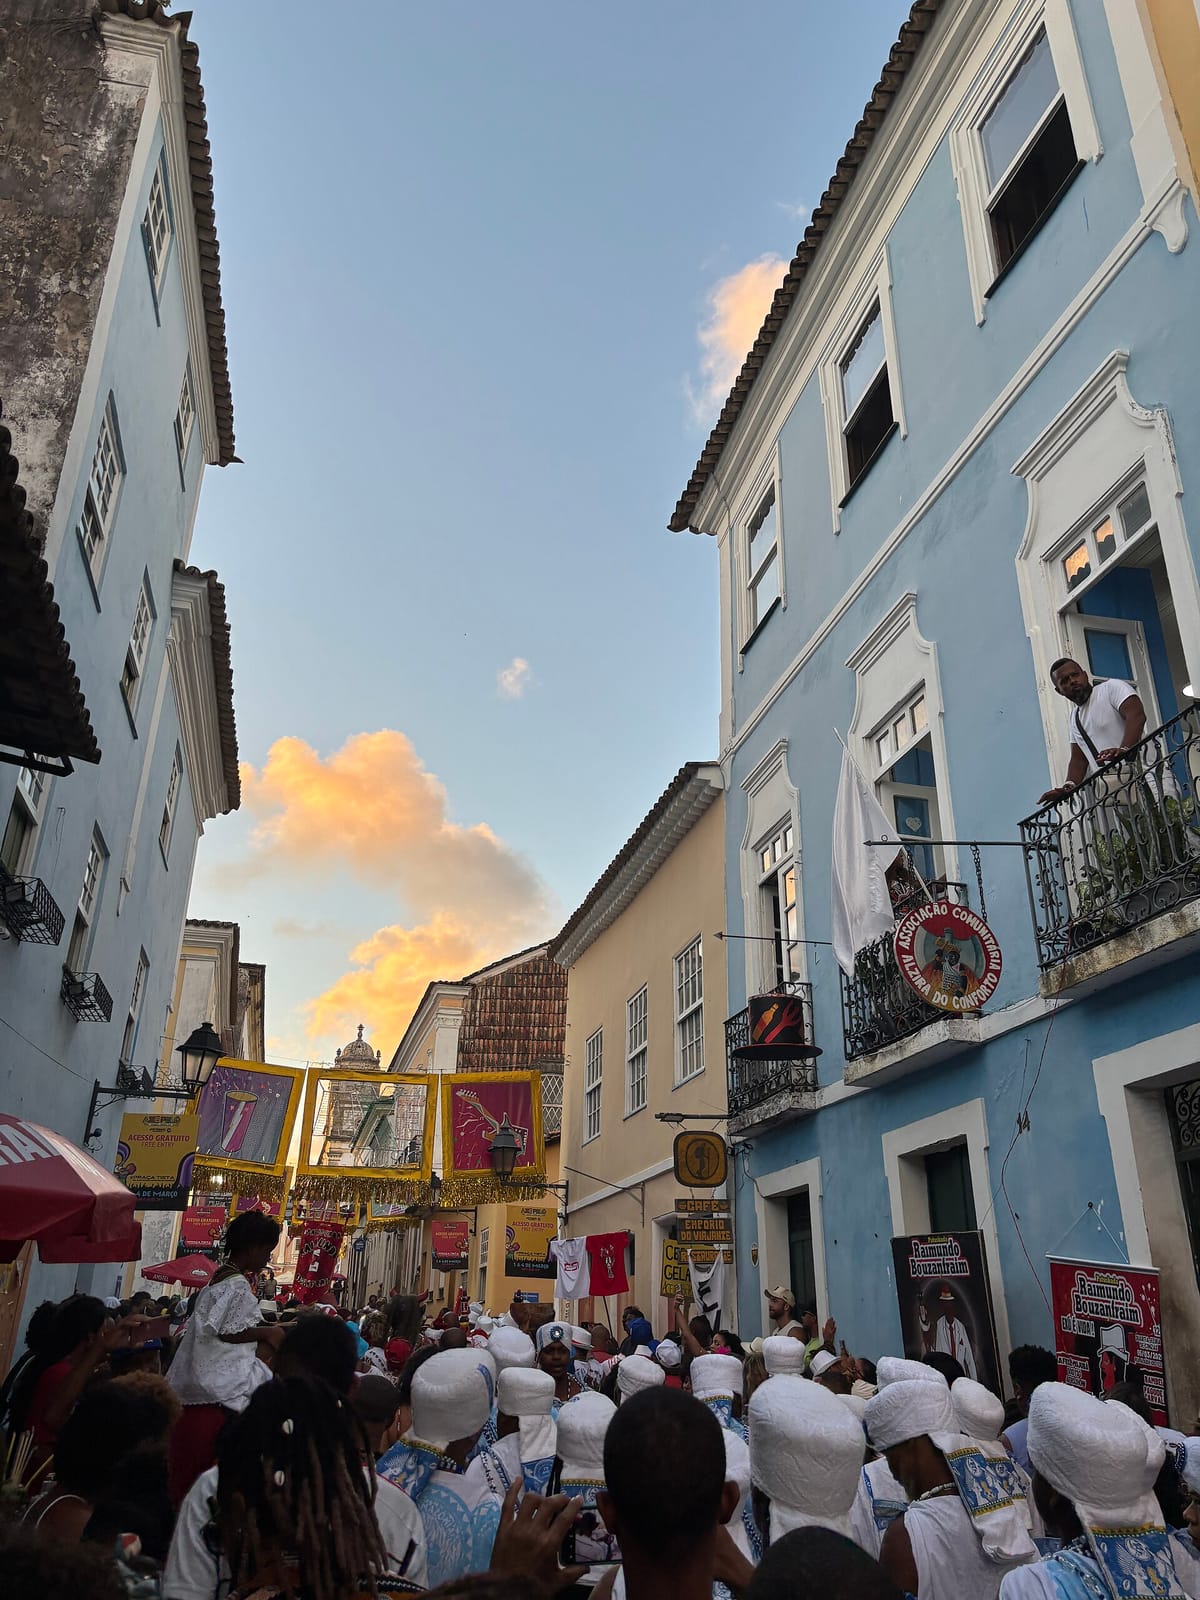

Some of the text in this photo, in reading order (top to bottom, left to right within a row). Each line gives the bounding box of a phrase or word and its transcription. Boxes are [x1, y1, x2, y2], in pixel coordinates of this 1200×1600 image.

[898, 903, 948, 950] ASSOCIAÇÃO
[901, 954, 998, 1010] ALZIRA DO CONFORTO
[128, 1134, 190, 1142] ACESSO GRATUITO
[152, 1190, 178, 1199] MARÇO
[681, 1231, 692, 1241] DO
[911, 1237, 961, 1259] Raimundo
[1078, 1275, 1132, 1303] Raimundo
